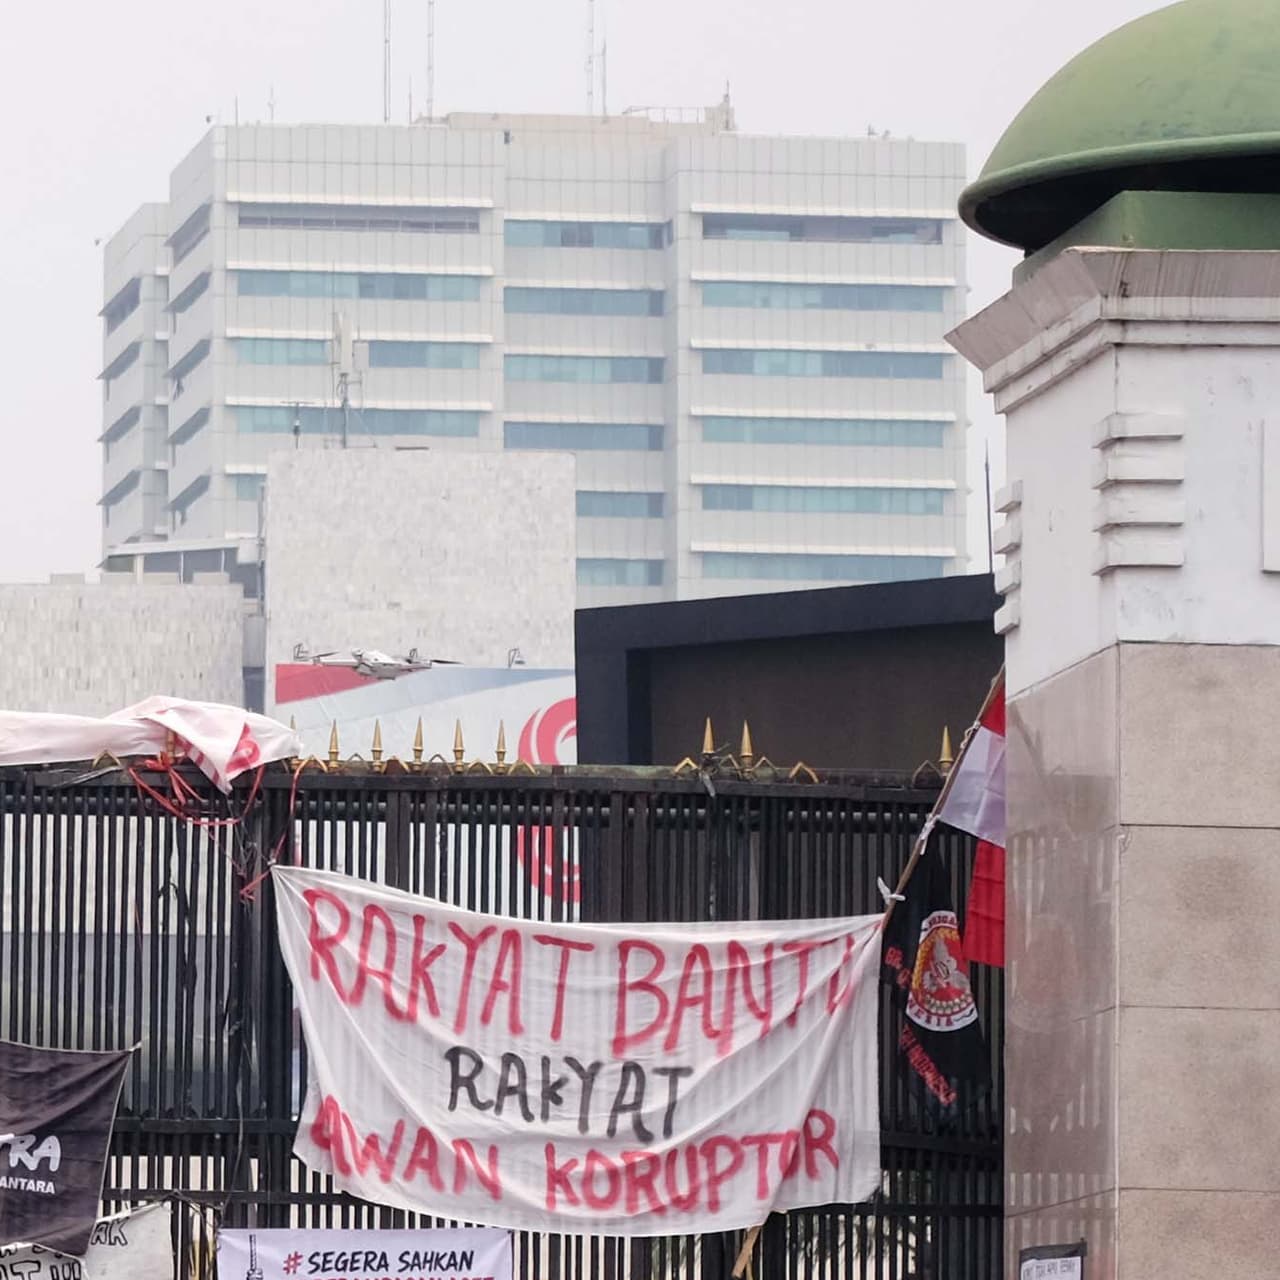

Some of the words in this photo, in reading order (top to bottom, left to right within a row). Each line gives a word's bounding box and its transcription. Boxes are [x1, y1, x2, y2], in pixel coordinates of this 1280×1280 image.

[302, 888, 594, 1042] RAKYAT
[444, 1045, 695, 1145] RAKYAT
[545, 1107, 840, 1216] KORUPTOR
[308, 1250, 390, 1275] SEGERA
[397, 1250, 475, 1273] SAHKAN
